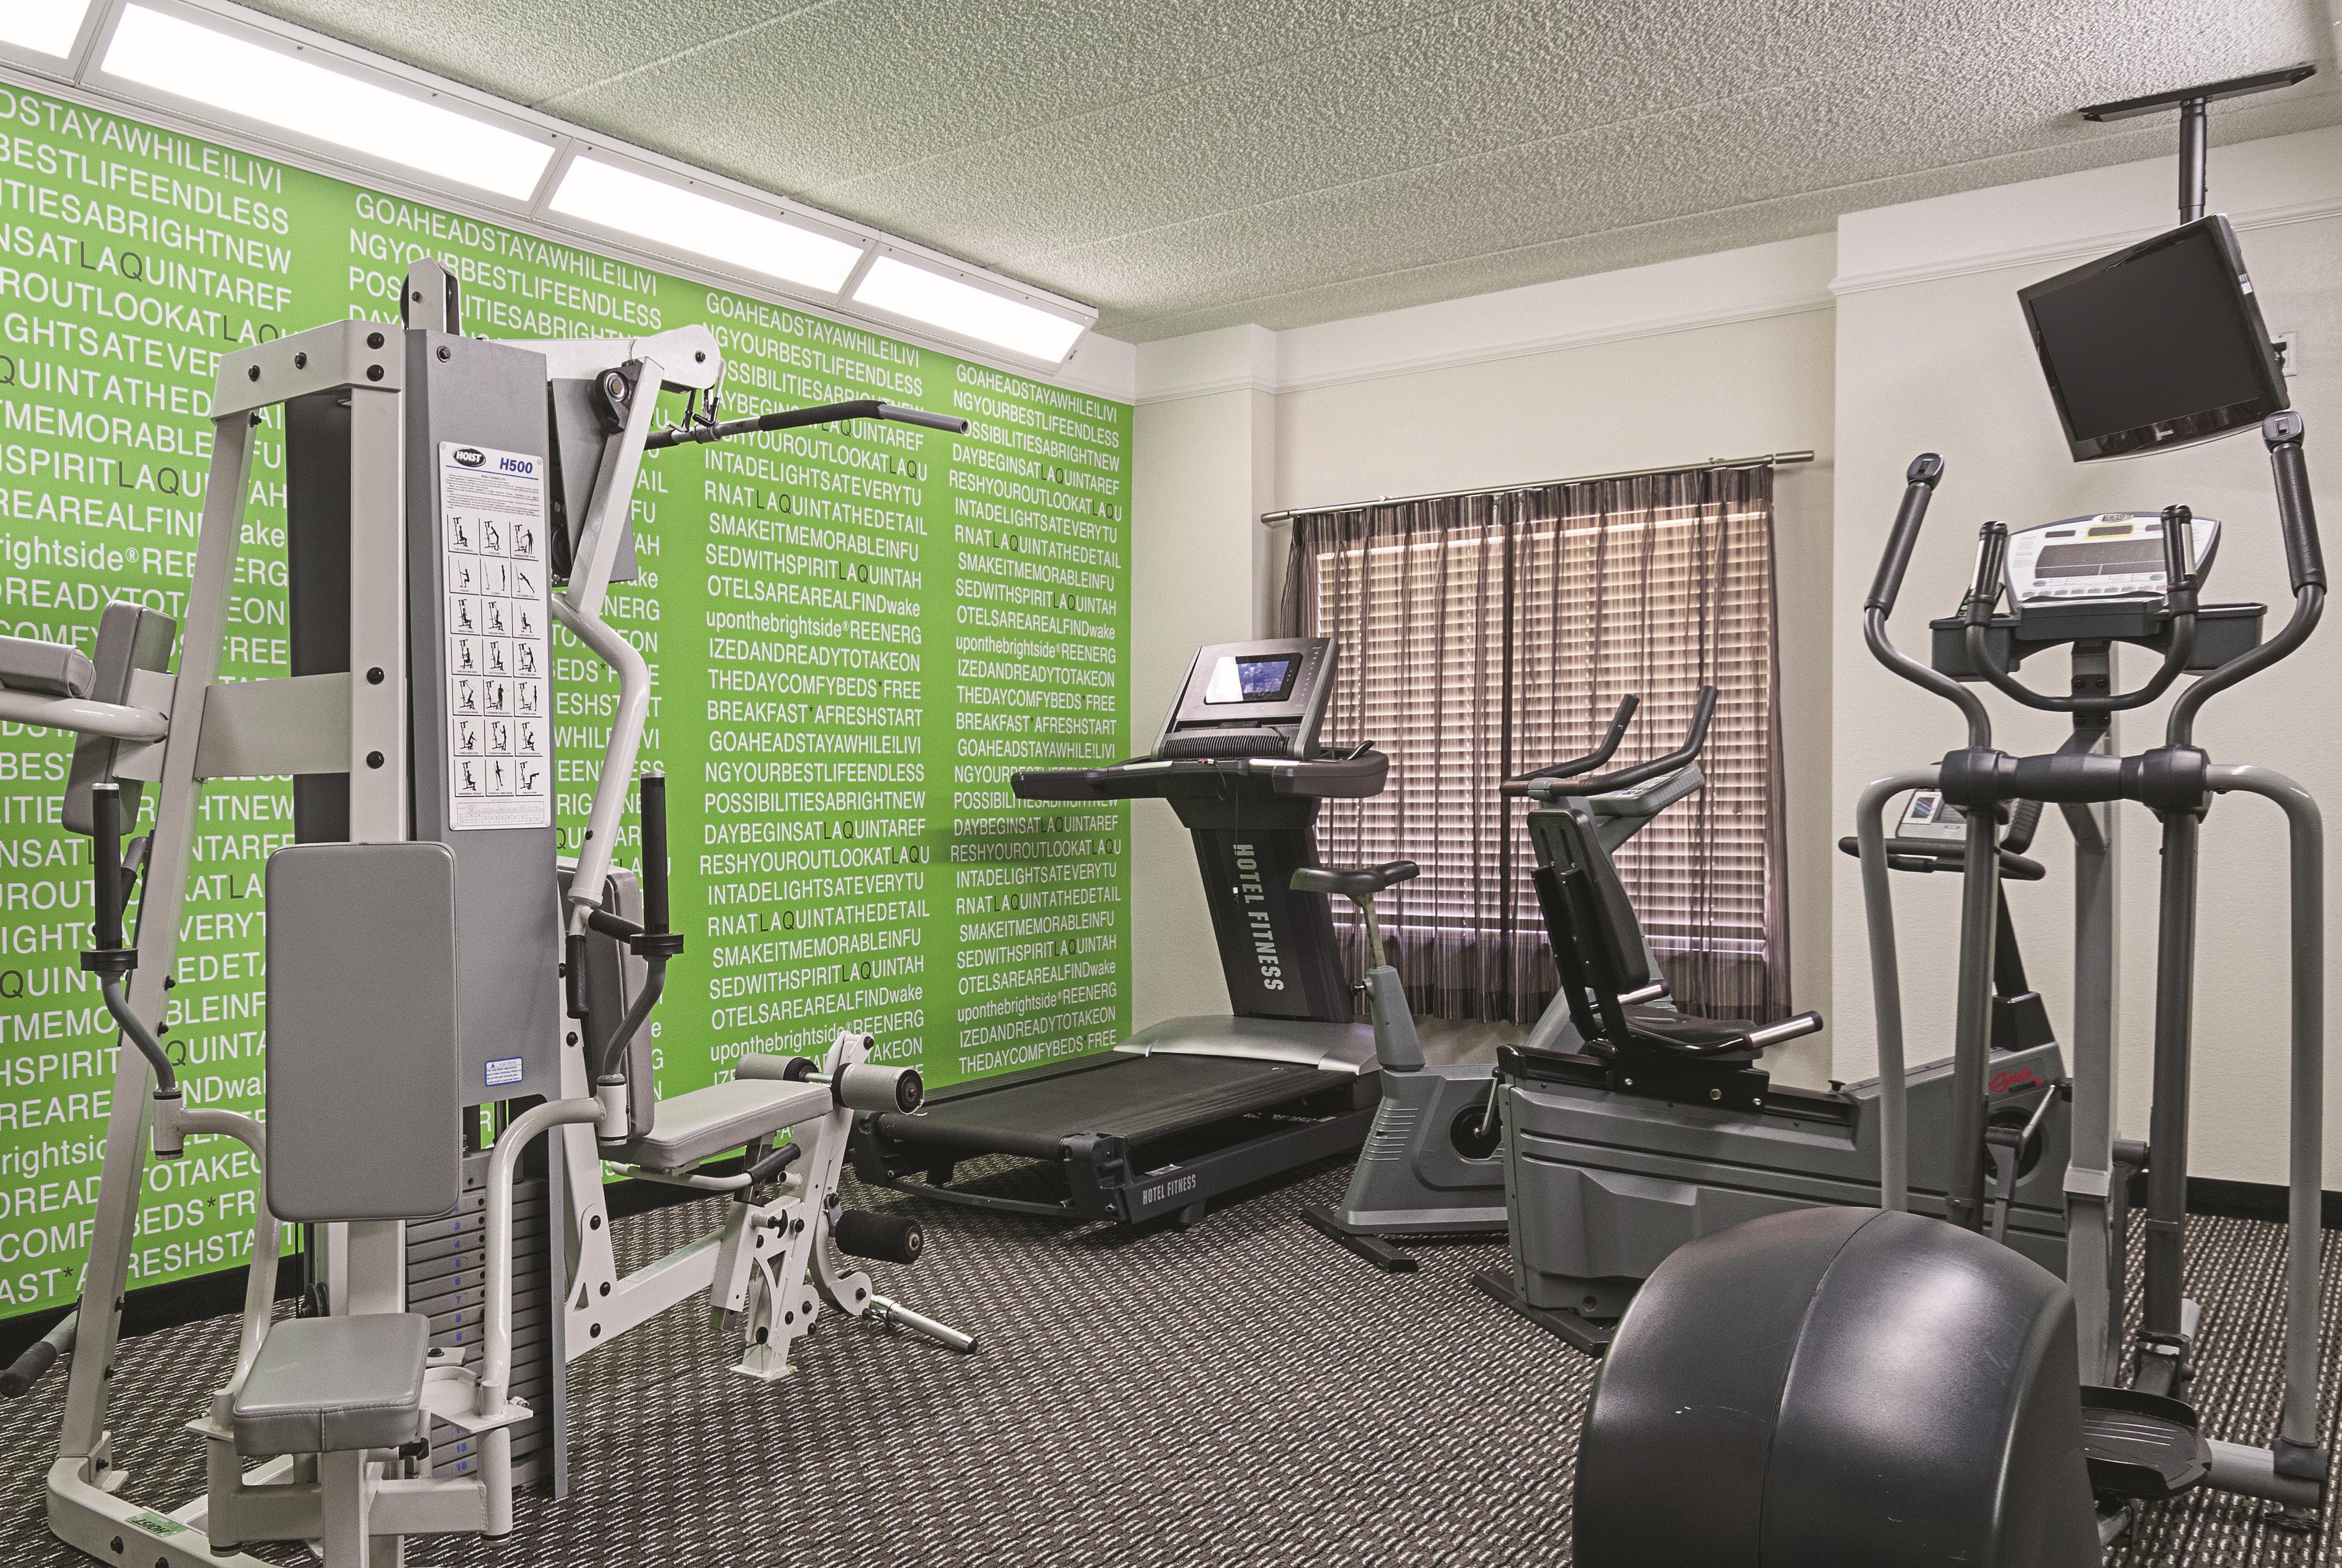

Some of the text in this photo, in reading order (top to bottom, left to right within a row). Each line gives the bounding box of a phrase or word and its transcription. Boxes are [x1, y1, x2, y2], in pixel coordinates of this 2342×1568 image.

[355, 192, 657, 297] GOAHEADSTAYAWHILE!LIVI
[0, 267, 298, 345] ROUTLOOKATLAQ
[706, 292, 919, 368] GOAHEADSTAYAWHILE!LIVI
[956, 363, 1117, 424] GOAHEADSTAYAWHILE!LIVI
[953, 389, 1119, 449] NGYOURBESTLIFEENDLESS
[456, 451, 482, 462] HOIST
[963, 418, 1120, 472] OSSIBILITIESABRIGHTNEW
[499, 457, 533, 474] H500
[704, 448, 922, 506] INTADELIGHTSATEVERYTU
[953, 444, 1119, 496] DAYBEGINSATLAQUINTAREF
[704, 481, 927, 536] RNATLAQUINTATHEDETAIL
[949, 470, 1122, 522] RESHYOUROUTLOOKATLAQU
[709, 512, 919, 561] SMAKEITMEMORABLEINFU
[955, 497, 1117, 544] INTADELIGHTSATEVERYTU
[955, 524, 1122, 569] RNATLAQUINTATHEDETAIL
[706, 543, 922, 590] SEDWITHSPIRITLAQUINTAH
[958, 552, 1115, 592] SMAKEITMEMORABLEINFU
[707, 574, 920, 617] OTELSAREAREALFINDwake
[956, 578, 1116, 617] SEDWITHSPIRITLAQUINTAH
[957, 605, 1116, 640] OTELSAREAREALFINDwake
[710, 638, 920, 672] IZEDANDREADYTOTAKEON
[958, 659, 1115, 688] IZEDANDREADYTOTAKEON
[709, 731, 921, 754] GOAHEADSTAYAWHILE!LIVI
[957, 738, 1115, 759] GOAHEADSTAYAWHILE!LIVI
[705, 761, 925, 783] NGYOURBESTLIFEENDLESS
[704, 791, 926, 814] POSSIBILITIESABRIGHTNEW
[704, 818, 926, 845] DAYBEGINSATLAQUINTAREF
[954, 815, 1119, 837] DAYBEGINSATLAQUINTAREF
[700, 845, 930, 875] RESHYOUROUTLOOKATLAQU
[950, 839, 1122, 863] RESHYOUROUTLOOKATLAQU
[708, 872, 924, 905] INTADELIGHTSATEVERYTU
[956, 863, 1117, 888] INTADELIGHTSATEVERYTU
[707, 900, 930, 937] RNATLAQUINTATHEDETAIL
[956, 886, 1122, 916] RNATLAQUINTATHEDETAIL
[1233, 844, 1285, 991] HOTEL FITNESS
[959, 911, 1114, 942] SMAKEITMEMORABLEINFU
[713, 928, 922, 968] SMAKEITMEMORABLEINFU
[957, 934, 1117, 970] SEDWITHSPIRITLAQUINTAH
[710, 954, 924, 1000] SEDWITHSPIRITLAQUINTAH
[959, 960, 1116, 996] OTELSAREAREALFINDwake
[711, 985, 923, 1031] OTELSAREAREALFINDwake
[959, 1006, 1116, 1048] IZEDANDREADYTOTAKEON
[1142, 1174, 1197, 1205] HOTEL FITNESS
